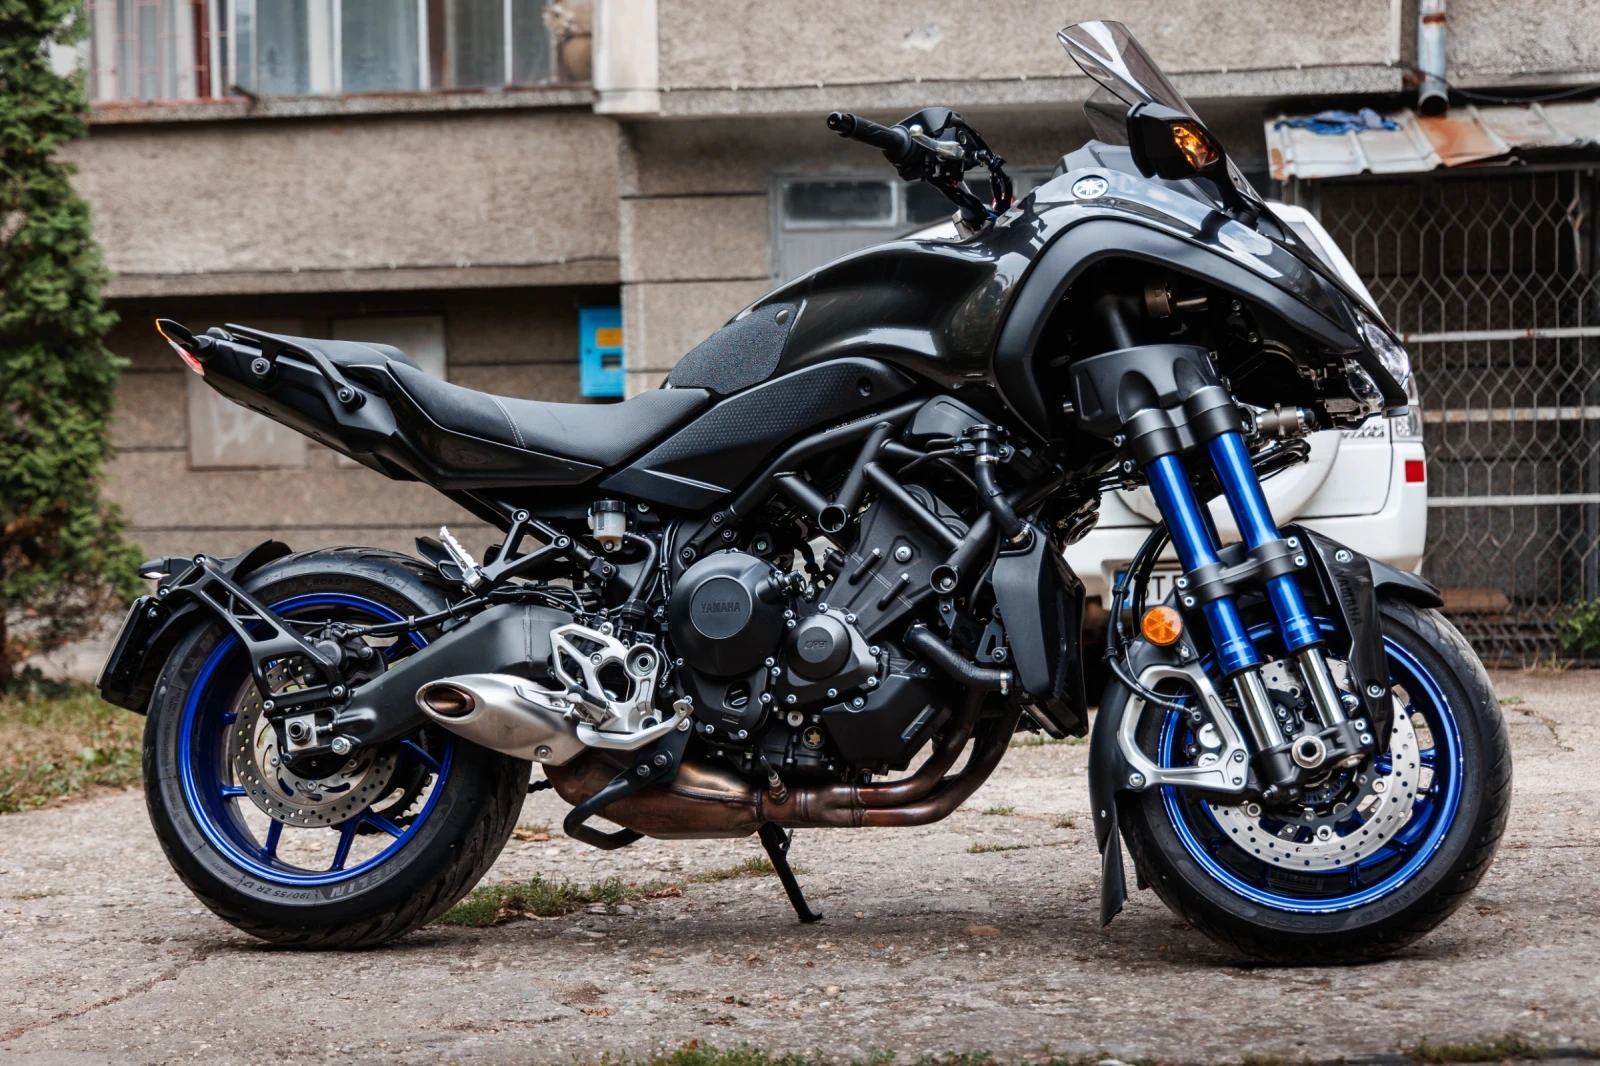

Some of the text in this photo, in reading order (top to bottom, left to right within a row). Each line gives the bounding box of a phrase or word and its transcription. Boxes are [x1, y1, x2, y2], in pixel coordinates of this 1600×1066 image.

[701, 602, 741, 613] YAMAHA
[1334, 570, 1362, 626] YAMAHA
[330, 823, 433, 899] MICHELIN
[242, 880, 311, 900] 190/55 ZR 17
